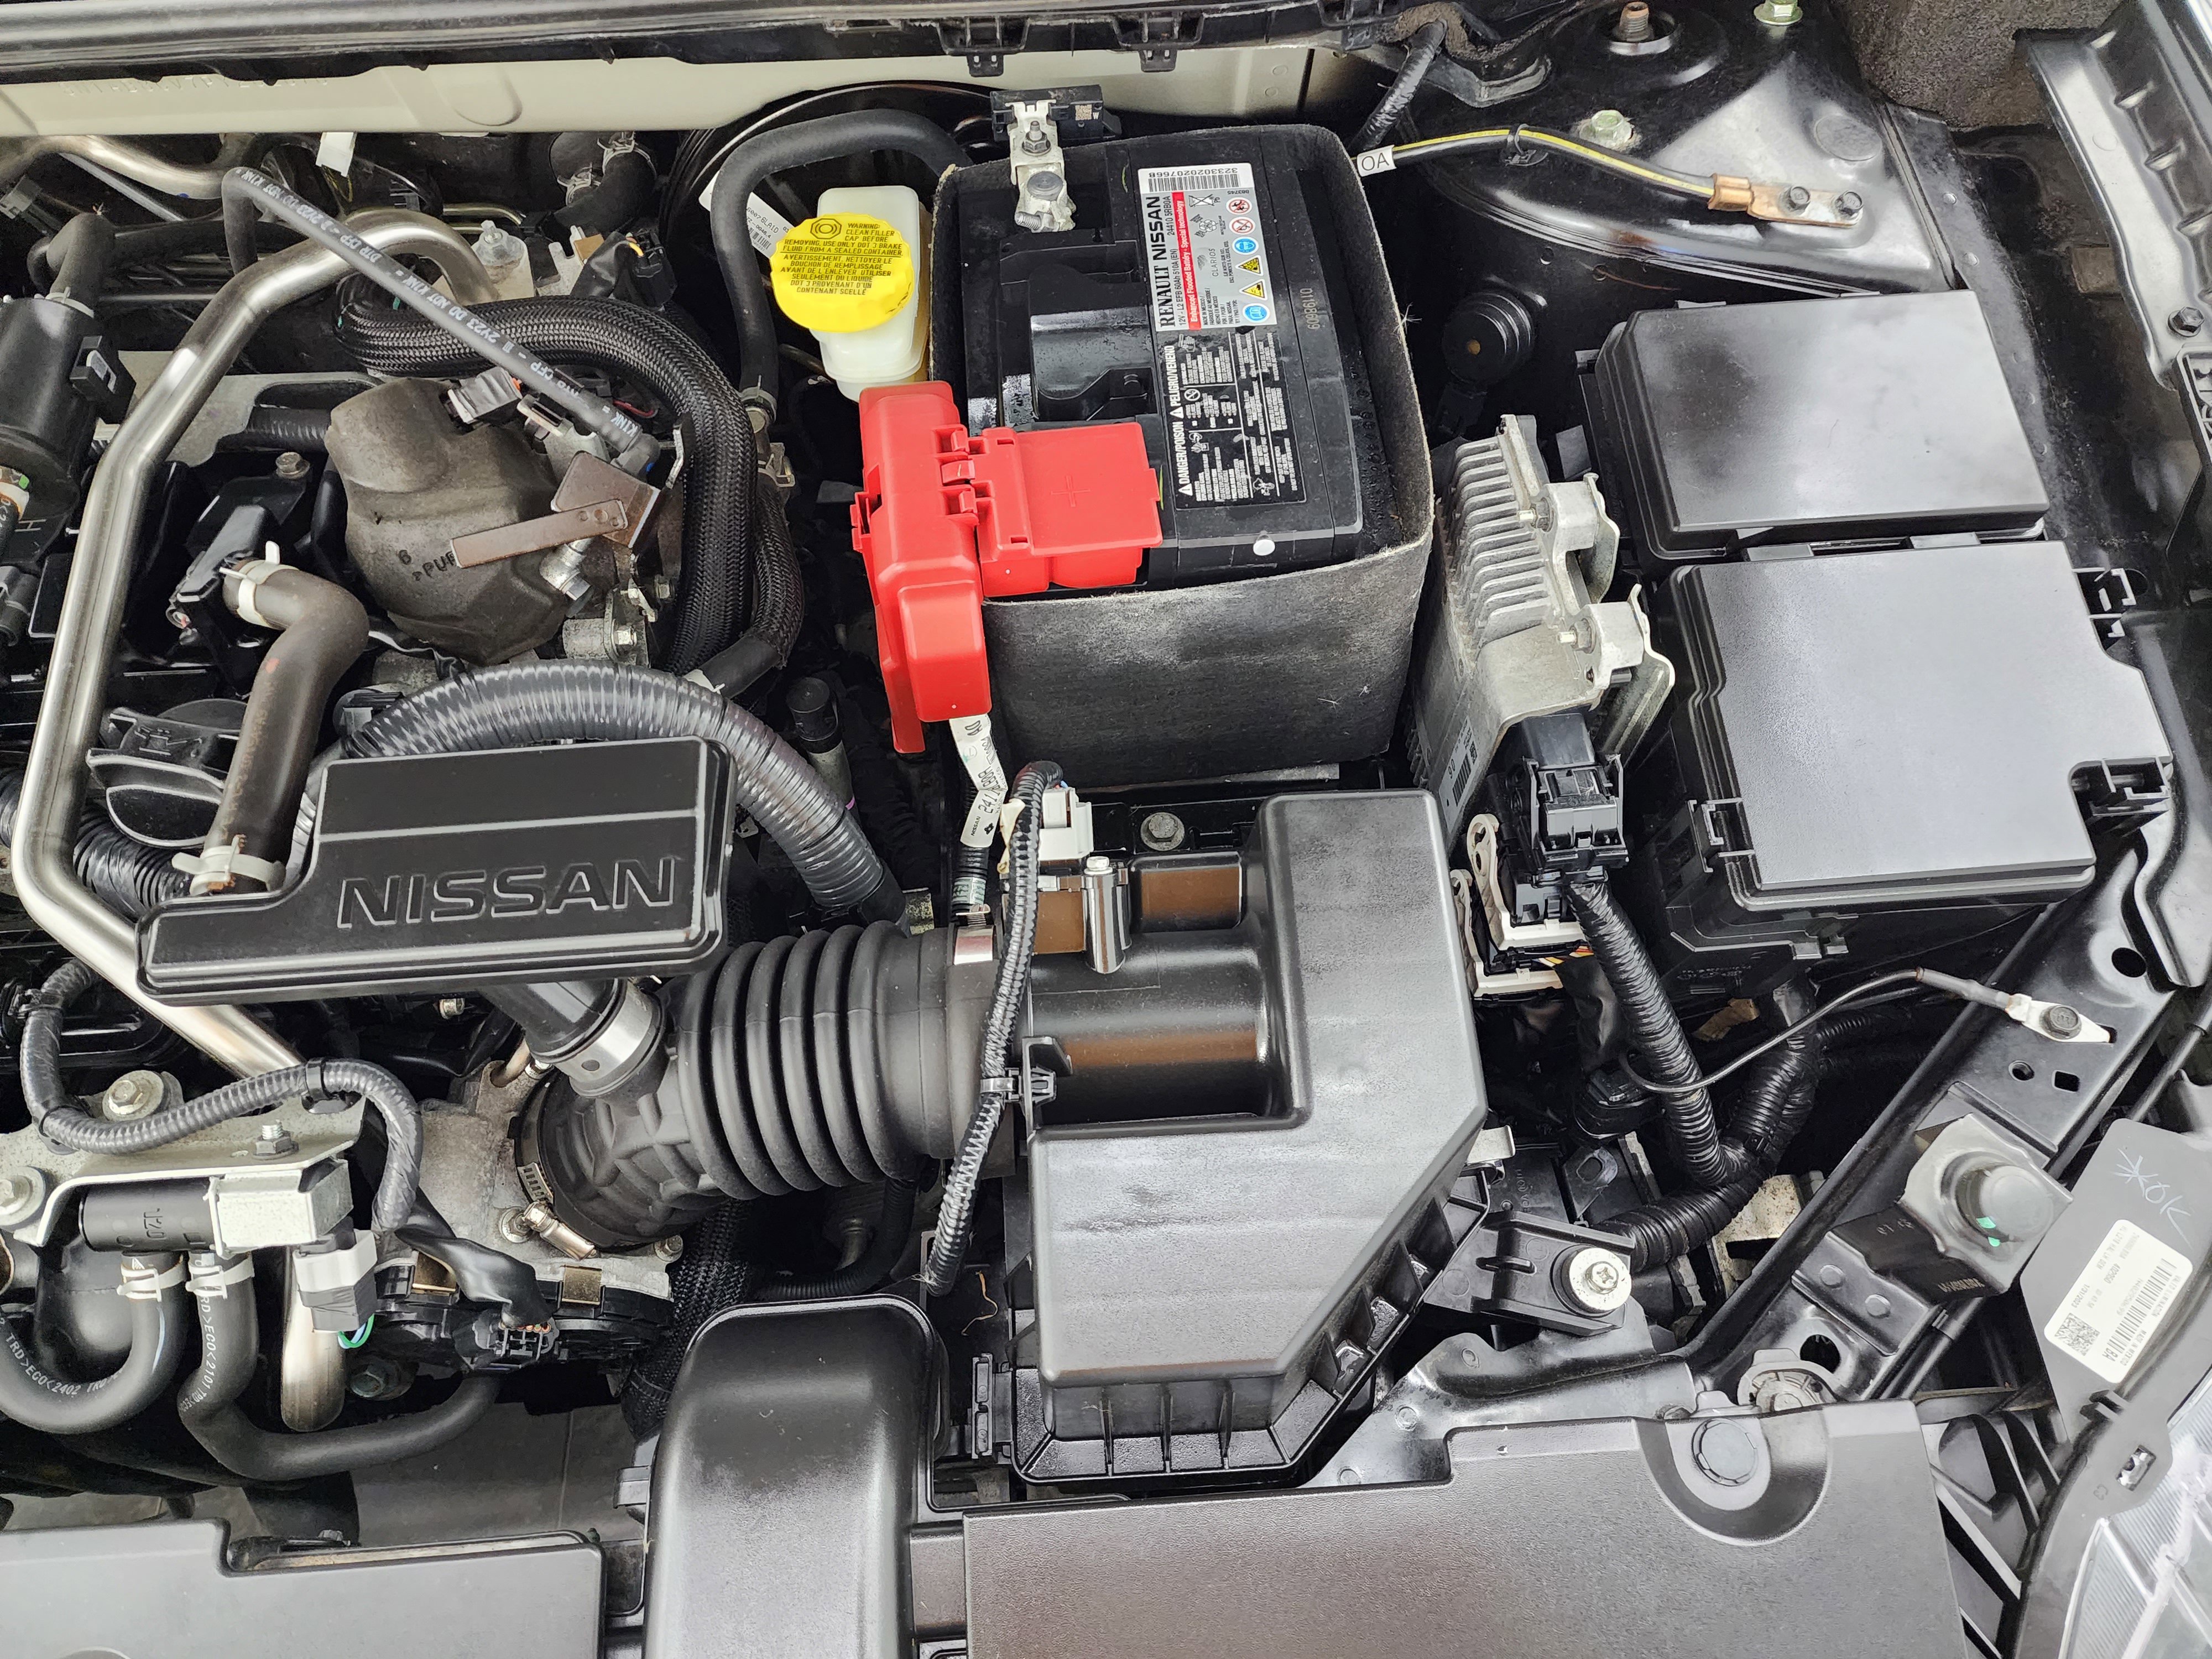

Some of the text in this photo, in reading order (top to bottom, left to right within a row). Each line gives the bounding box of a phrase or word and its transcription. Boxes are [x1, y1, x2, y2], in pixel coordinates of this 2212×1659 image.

[1175, 200, 1186, 228] technology
[1165, 217, 1175, 236] 24410
[1178, 228, 1189, 248] Special
[1146, 195, 1175, 327] RENAULT NISSAN
[1168, 248, 1179, 260] (EN)
[1208, 247, 1219, 277] CLARIOS
[1170, 260, 1180, 275] 510A
[401, 272, 430, 297] KINK
[1172, 275, 1182, 290] 60Ah
[1184, 271, 1194, 293] Flooded
[425, 288, 451, 310] NOT
[1175, 290, 1183, 302] EFB
[447, 302, 468, 322] DO
[1186, 293, 1198, 322] Enhanced
[1300, 288, 1321, 330] 01198609
[465, 315, 501, 345] 2Y23
[1177, 314, 1186, 325] 12V
[528, 357, 556, 382] CFP
[608, 410, 640, 437] KINK
[1164, 344, 1191, 484] DANGER/POISON PELIGRO/VENENO
[970, 815, 981, 836] NISSAN
[337, 857, 675, 928] NISSAN
[2133, 1328, 2147, 1344] MADE
[2101, 1347, 2119, 1363] BA
